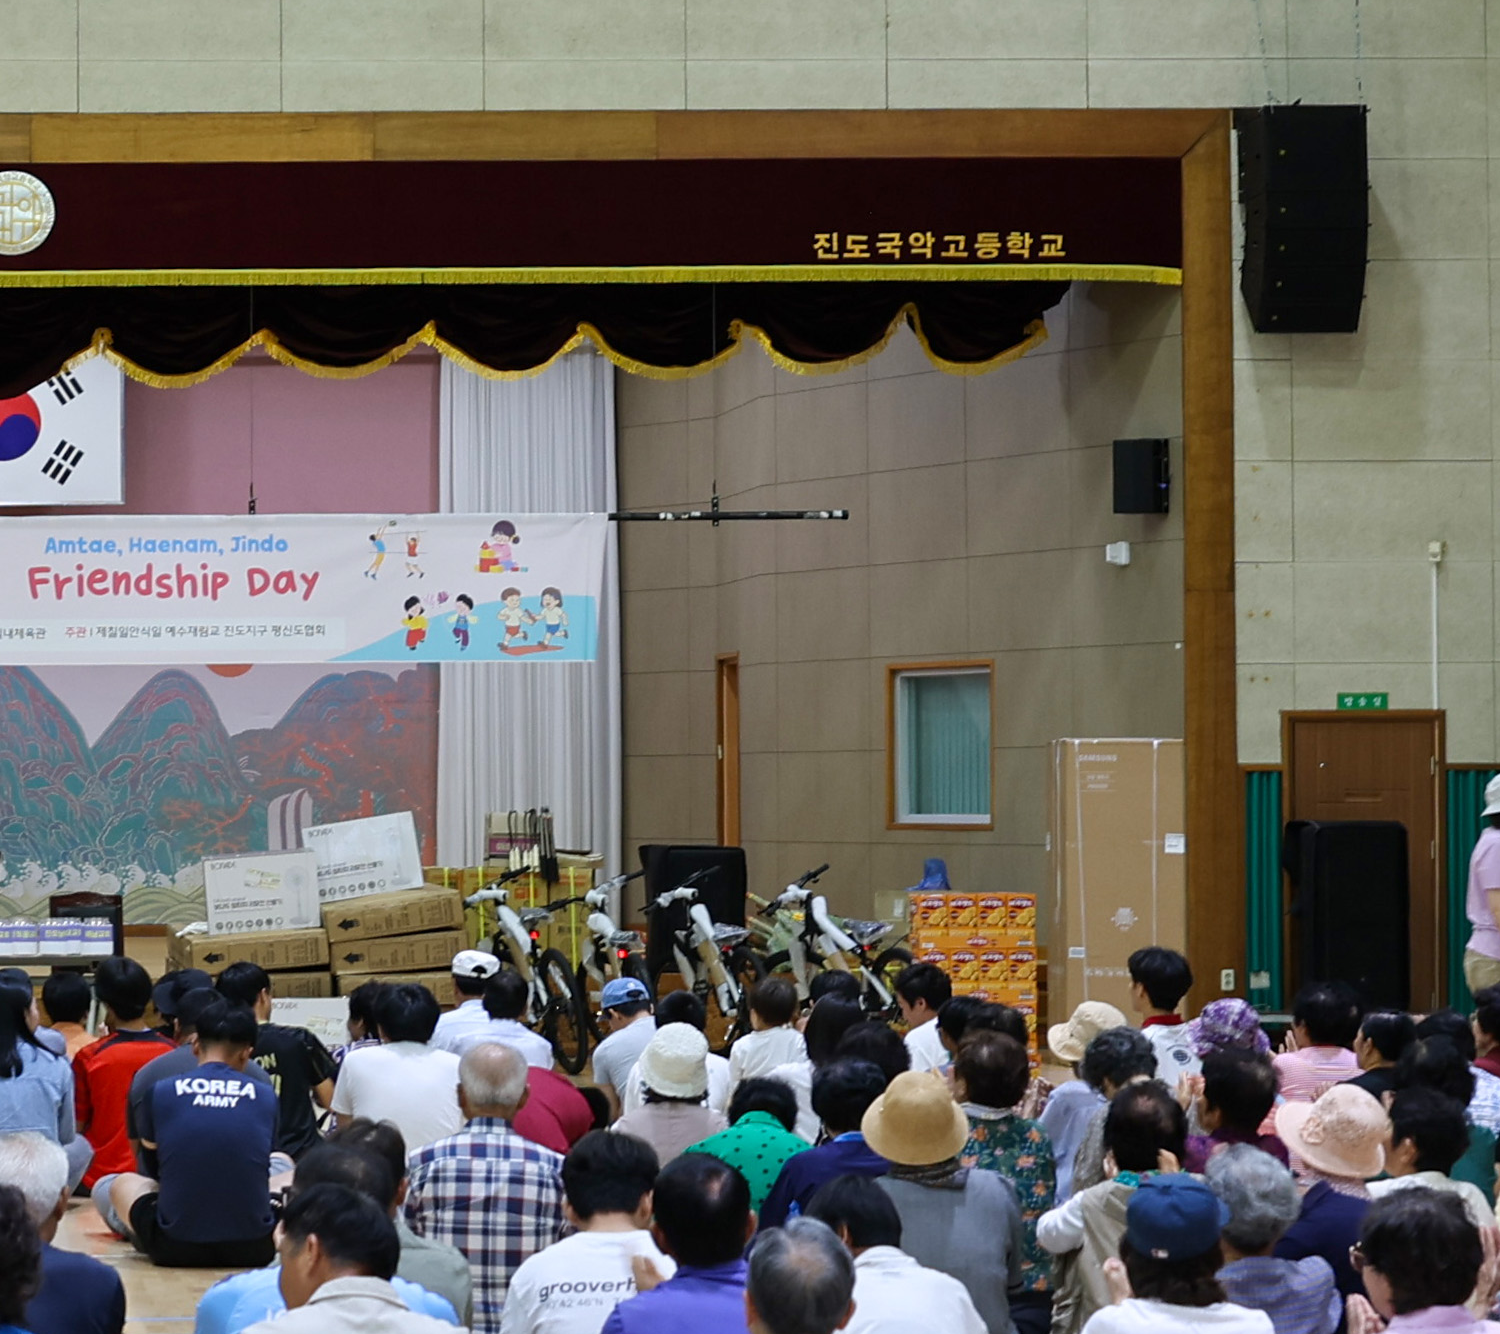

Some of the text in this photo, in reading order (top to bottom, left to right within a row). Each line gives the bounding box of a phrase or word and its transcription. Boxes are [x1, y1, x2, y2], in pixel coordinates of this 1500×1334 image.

[813, 231, 1067, 260] 진도국악고등학교
[44, 535, 290, 556] Amtae, Haenam, Jindo
[28, 563, 320, 601] Friendship Day
[64, 624, 326, 639] 주관 제칠일안식일 예수재림교 진도지구 평신도협회
[1079, 754, 1118, 763] SAMSUNG
[175, 1078, 256, 1100] KOREA
[193, 1094, 240, 1108] ARMY
